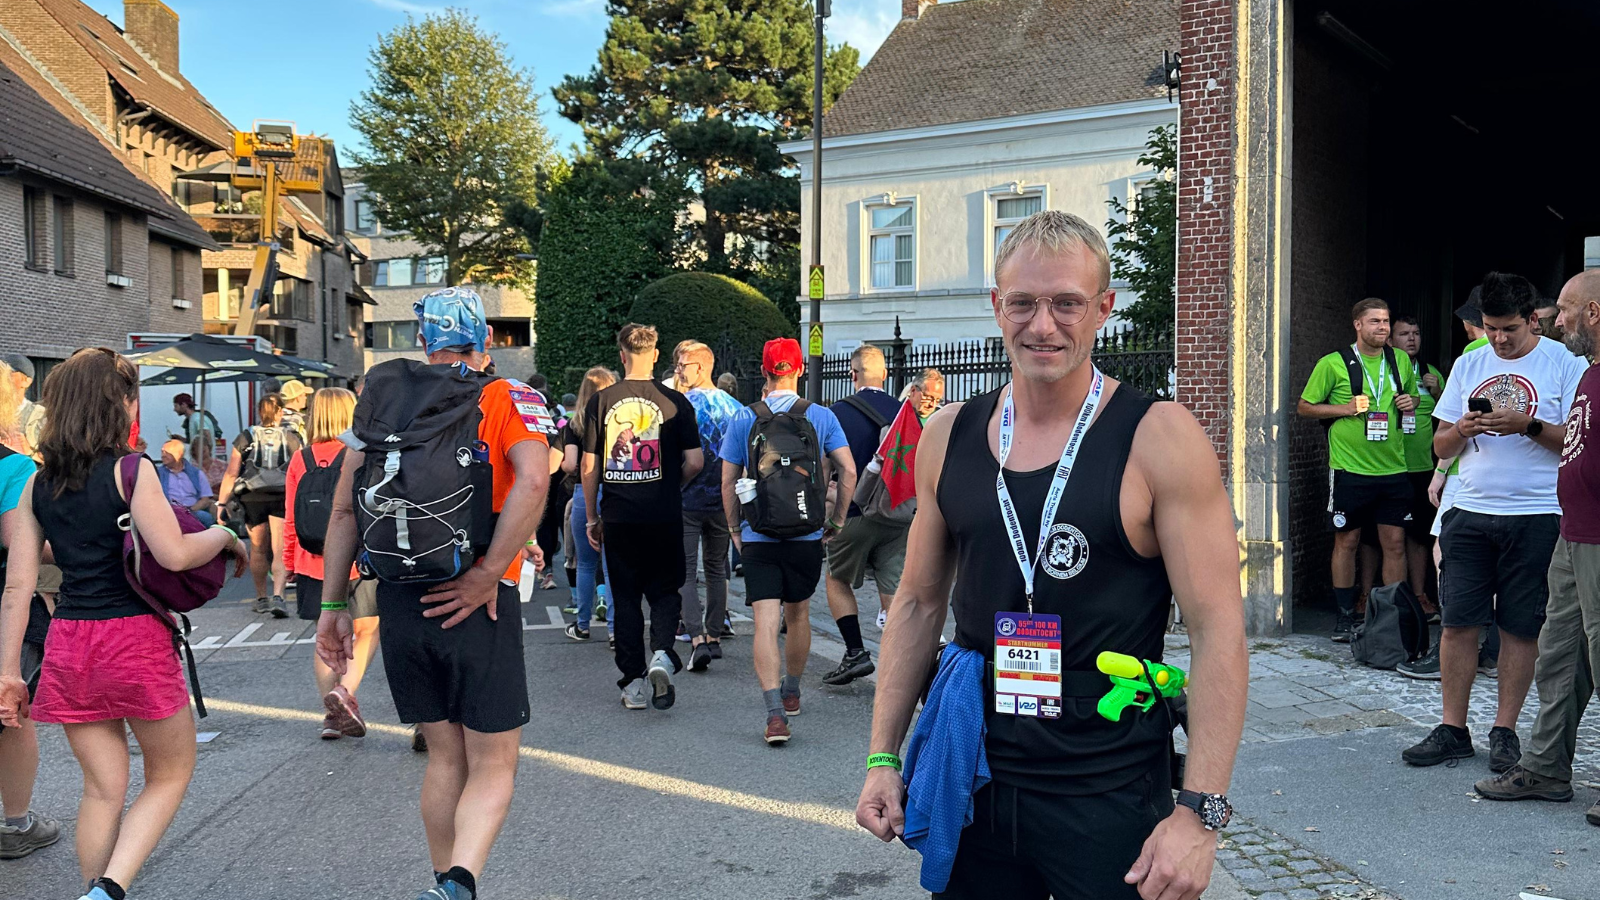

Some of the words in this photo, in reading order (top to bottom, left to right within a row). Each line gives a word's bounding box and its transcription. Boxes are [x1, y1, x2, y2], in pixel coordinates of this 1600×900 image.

[1095, 375, 1103, 397] DAF
[1080, 402, 1094, 422] 100km
[1065, 422, 1086, 457] Dodentocht
[605, 469, 660, 481] ORIGINALS
[1056, 465, 1071, 480] FIAT
[1003, 499, 1020, 539] Dodentocht
[1015, 539, 1027, 562] 100km
[1035, 621, 1046, 629] 100
[1047, 621, 1058, 630] KM
[1008, 640, 1048, 648] STARTNUMMER
[1008, 649, 1039, 660] 6421
